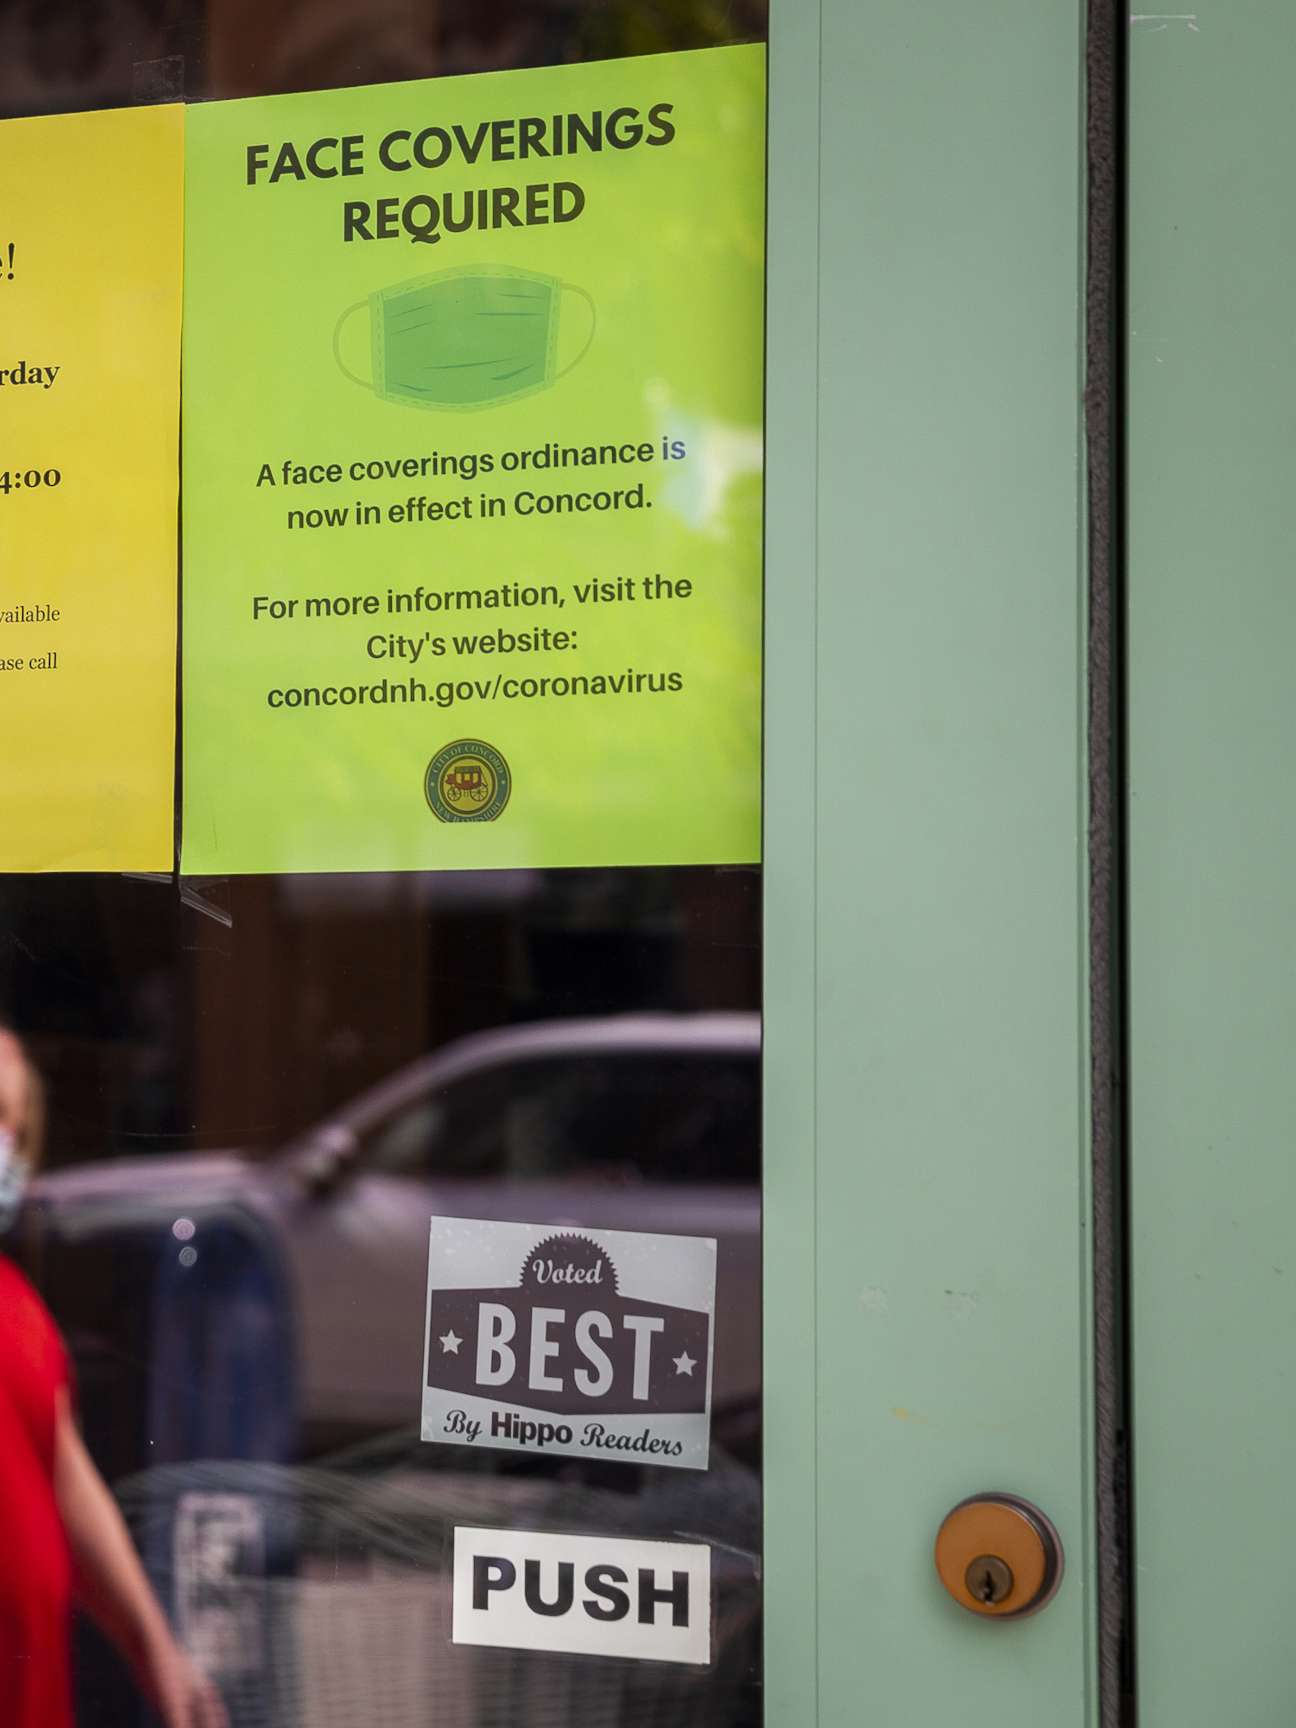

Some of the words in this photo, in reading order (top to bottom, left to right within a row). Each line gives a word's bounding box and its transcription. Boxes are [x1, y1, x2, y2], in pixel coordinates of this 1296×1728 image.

[247, 135, 363, 185] FACE
[379, 103, 675, 171] COVERINGS
[344, 182, 585, 244] REQUIRED
[256, 464, 275, 487] A
[282, 461, 342, 485] face
[350, 452, 494, 480] coverings
[501, 444, 654, 470] ordinance
[663, 436, 685, 460] is
[288, 508, 348, 529] now
[356, 502, 380, 525] in
[389, 497, 472, 522] effect
[481, 494, 505, 517] in
[515, 484, 651, 515] Concord.
[254, 597, 298, 619] For
[306, 596, 379, 617] more
[388, 583, 565, 613] information,
[573, 577, 635, 603] visit
[642, 574, 692, 599] the
[29, 652, 56, 669] call
[367, 632, 445, 663] City's
[453, 627, 577, 654] website:
[268, 669, 682, 707] concordnh.gov/coronavirus
[533, 1260, 602, 1283] Voted
[475, 1301, 665, 1401] BEST
[444, 1410, 482, 1442] By
[491, 1411, 573, 1446] Hippo
[580, 1424, 682, 1456] Readers
[473, 1556, 689, 1627] PUSH
